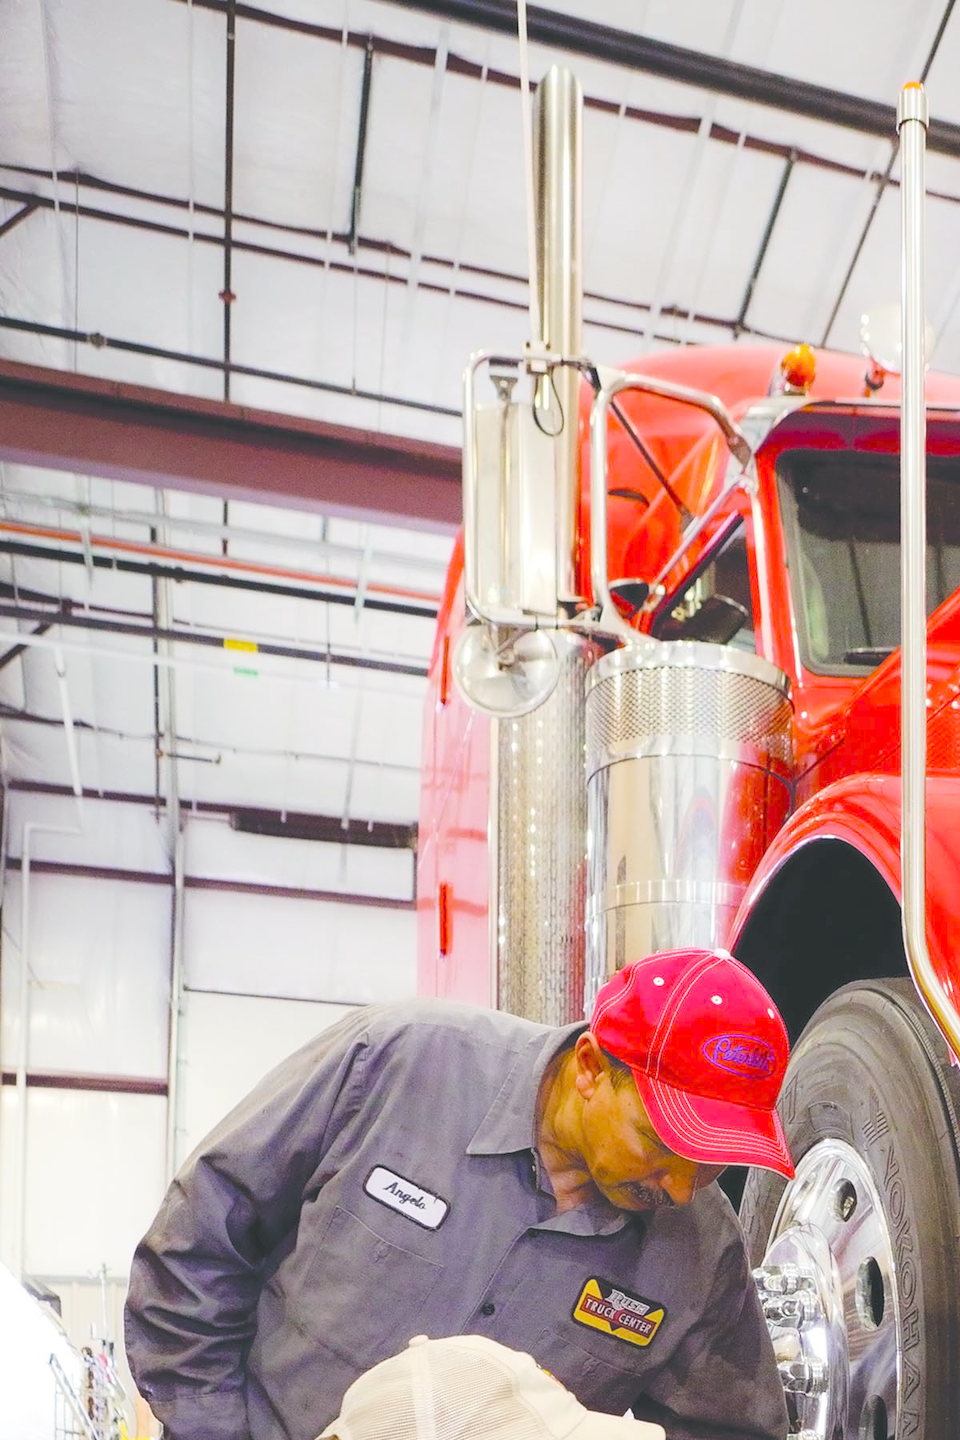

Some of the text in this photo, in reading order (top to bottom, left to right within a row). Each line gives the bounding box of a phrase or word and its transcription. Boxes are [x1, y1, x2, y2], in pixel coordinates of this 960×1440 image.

[383, 1181, 427, 1210] Angelo
[586, 1298, 652, 1334] TRUCK CENTER
[604, 1289, 650, 1315] RUSH
